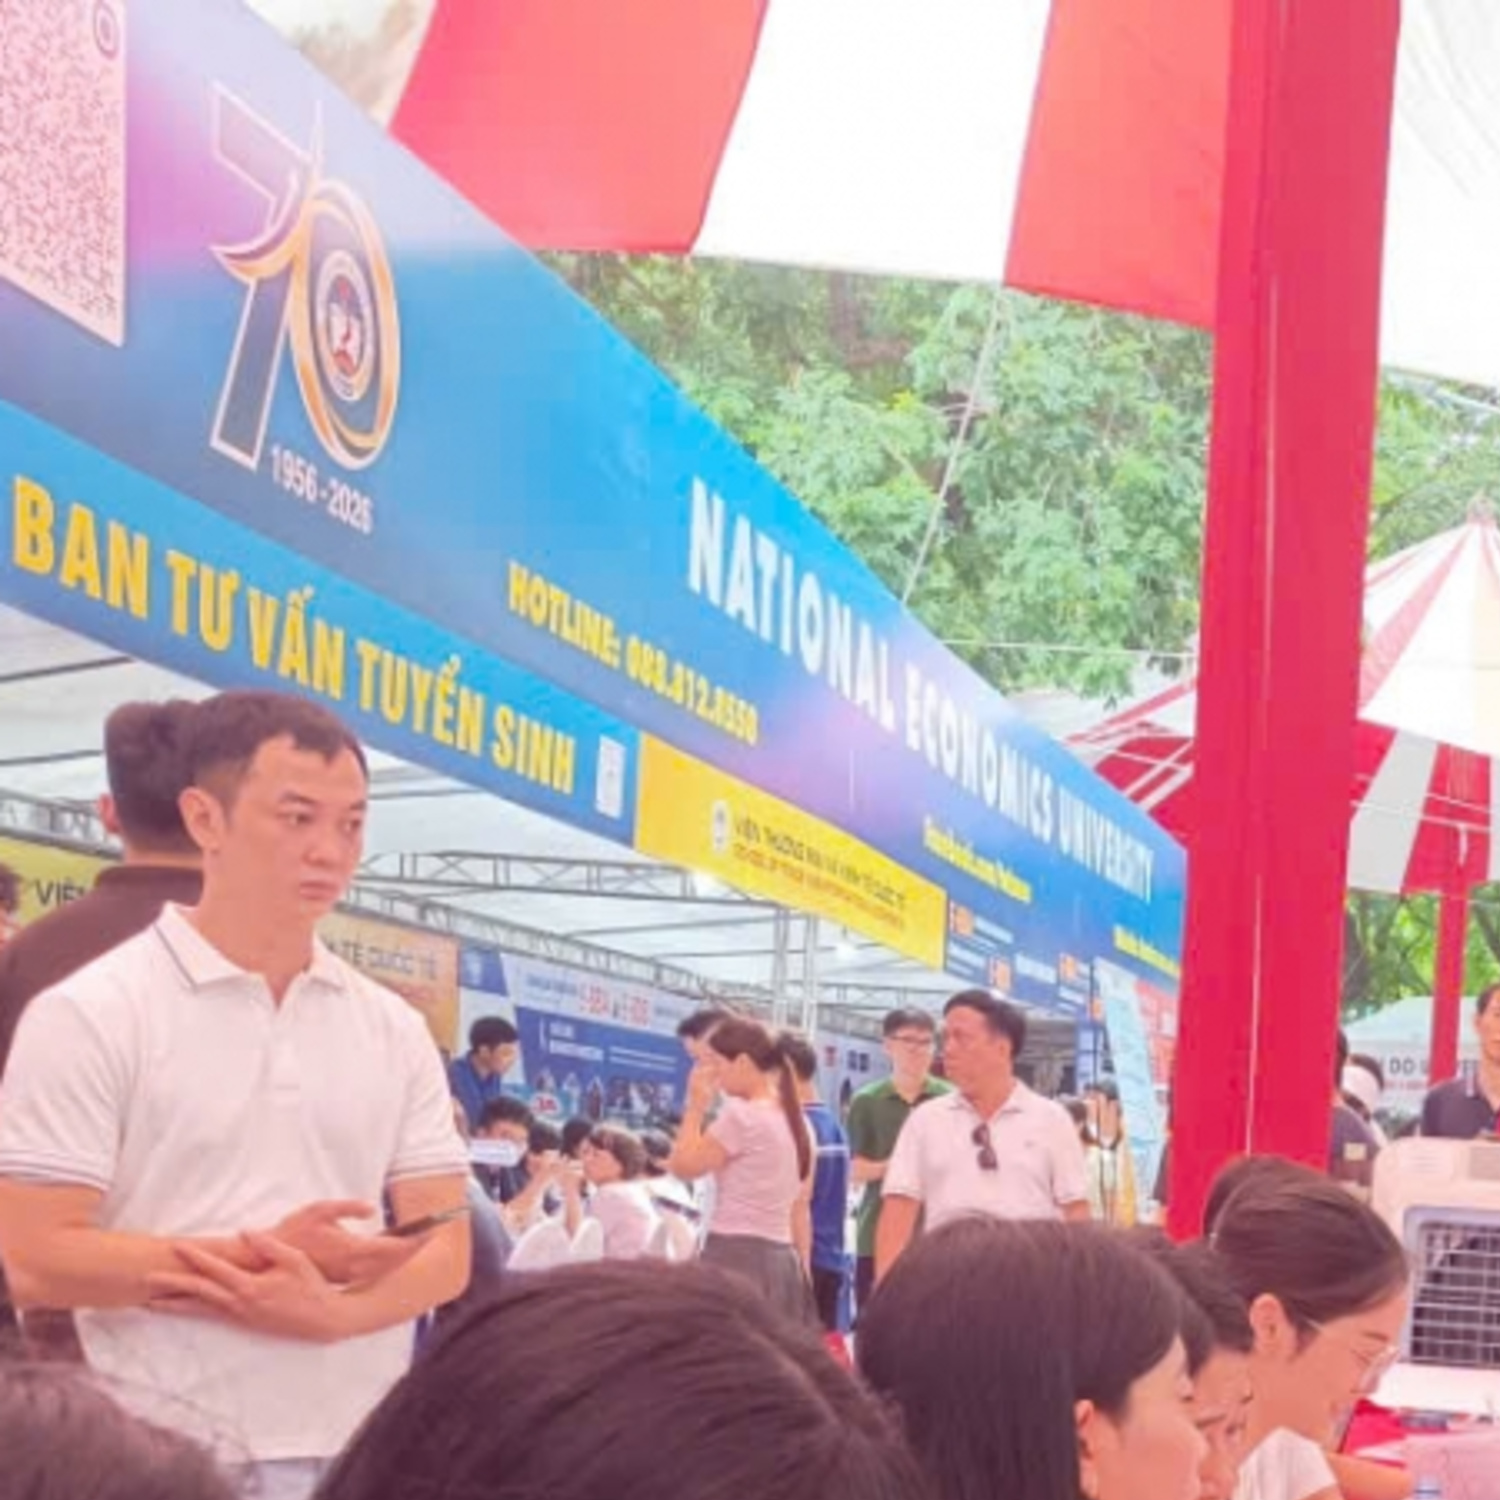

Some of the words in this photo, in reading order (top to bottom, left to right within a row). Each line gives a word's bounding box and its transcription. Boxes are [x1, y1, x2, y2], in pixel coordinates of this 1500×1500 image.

[13, 474, 150, 622] BAN
[165, 548, 242, 652] TƯ
[246, 584, 346, 701] VẤN
[492, 703, 575, 796] SINH
[687, 474, 897, 734] NATIONAL
[905, 662, 1054, 845] ECONOMICS
